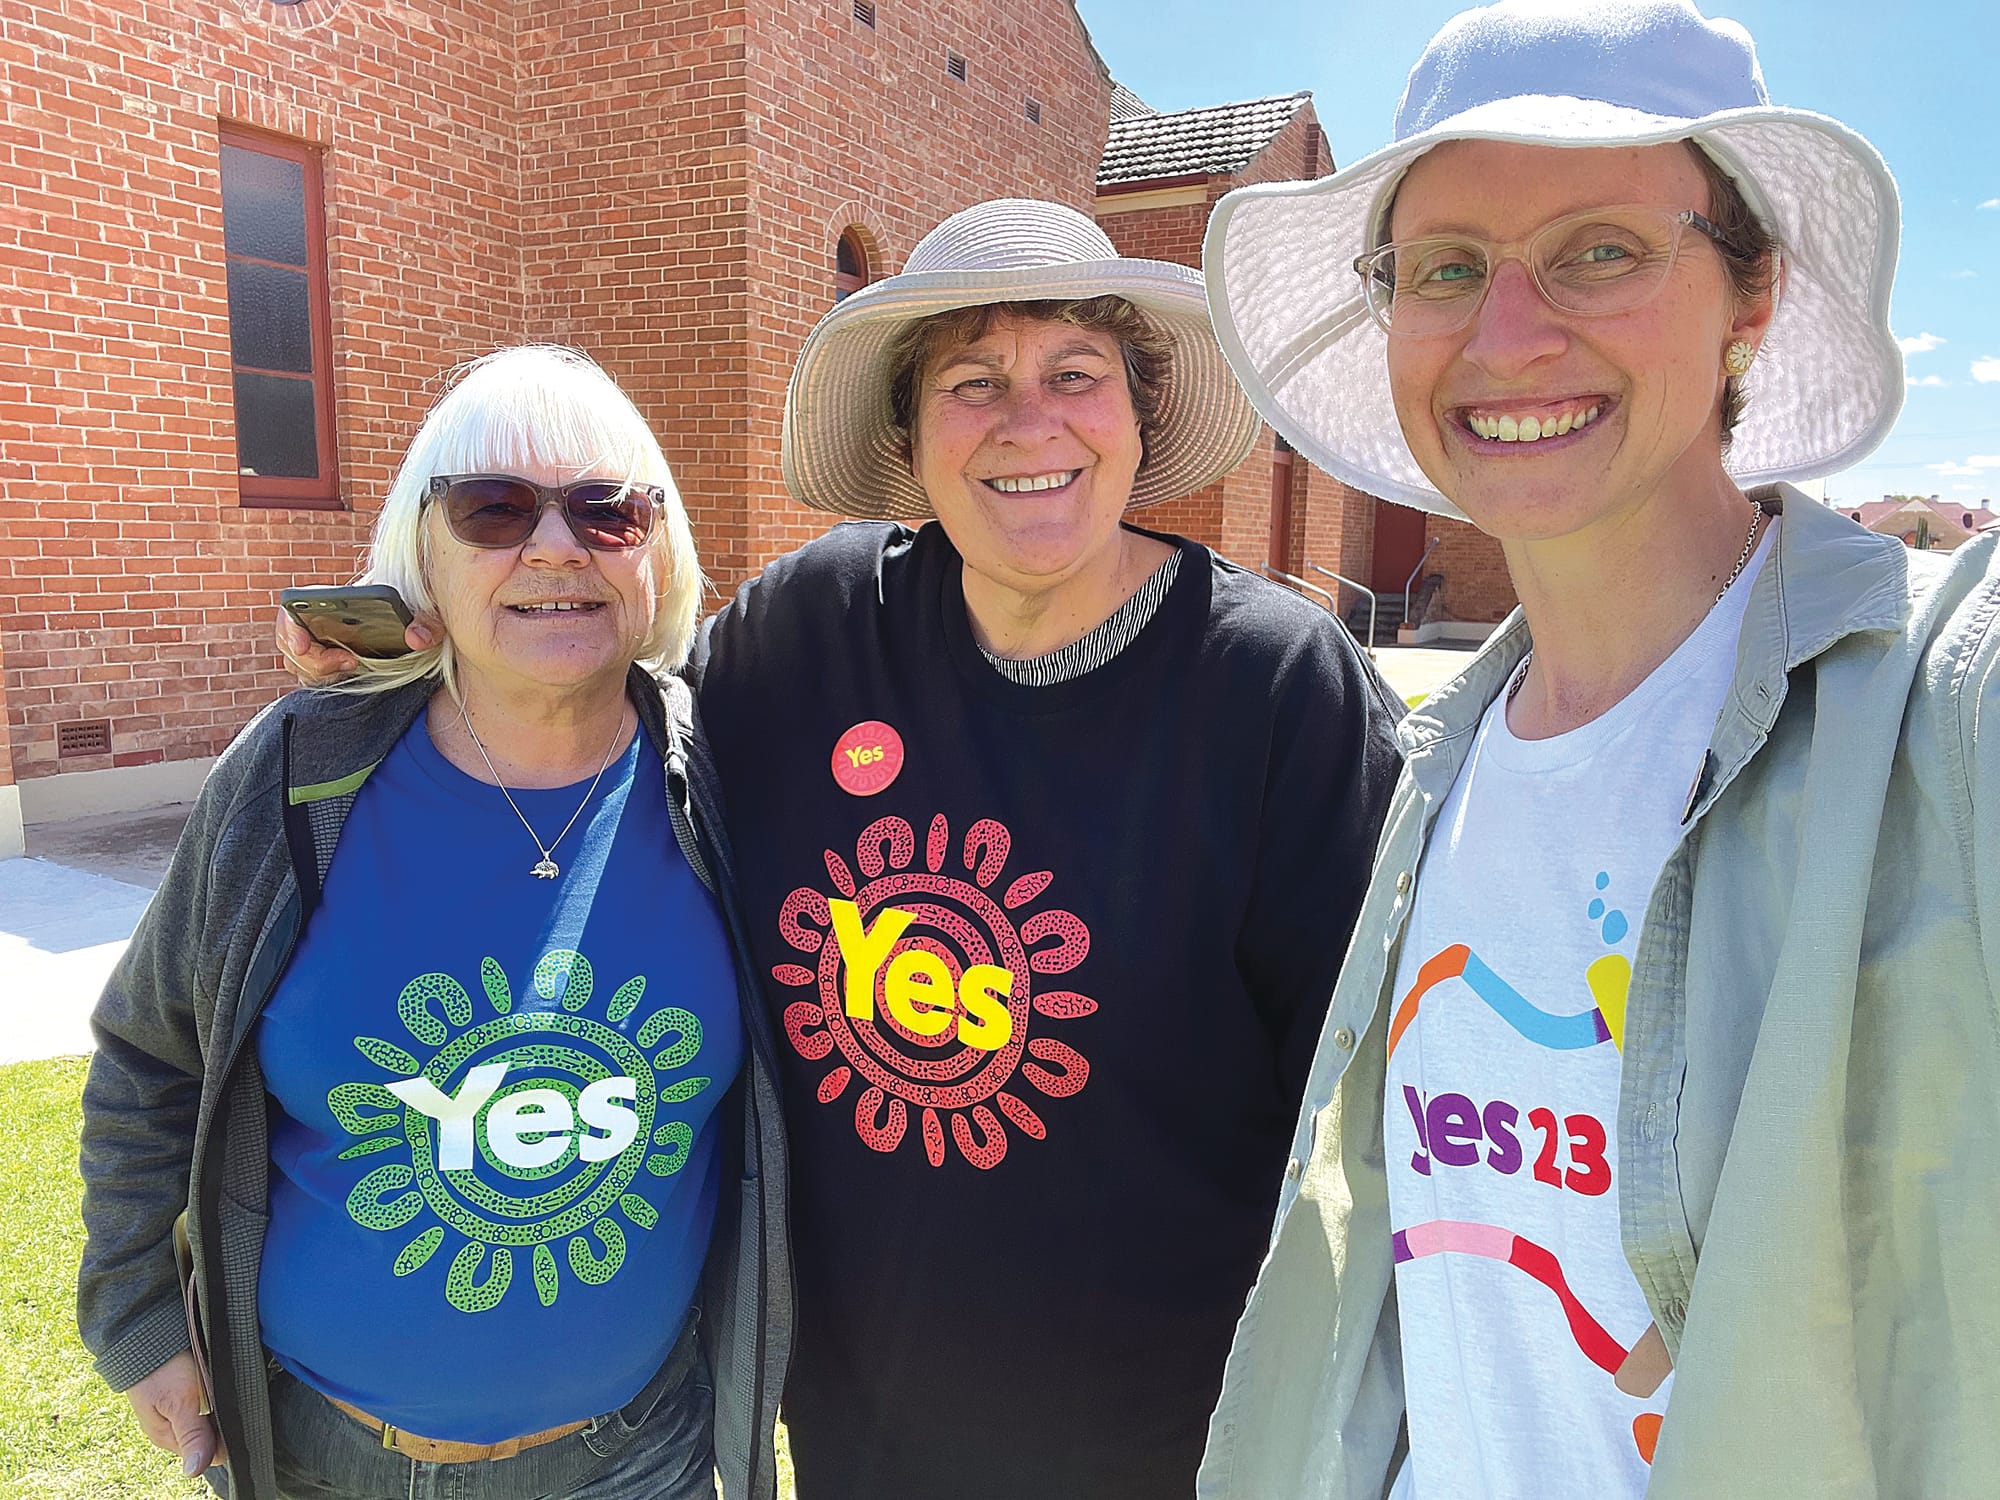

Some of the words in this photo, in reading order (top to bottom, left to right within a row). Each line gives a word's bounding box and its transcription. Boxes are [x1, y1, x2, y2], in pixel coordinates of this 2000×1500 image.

[845, 746, 884, 768] Yes
[828, 898, 1014, 1051] Yes
[384, 1061, 640, 1171] Yes
